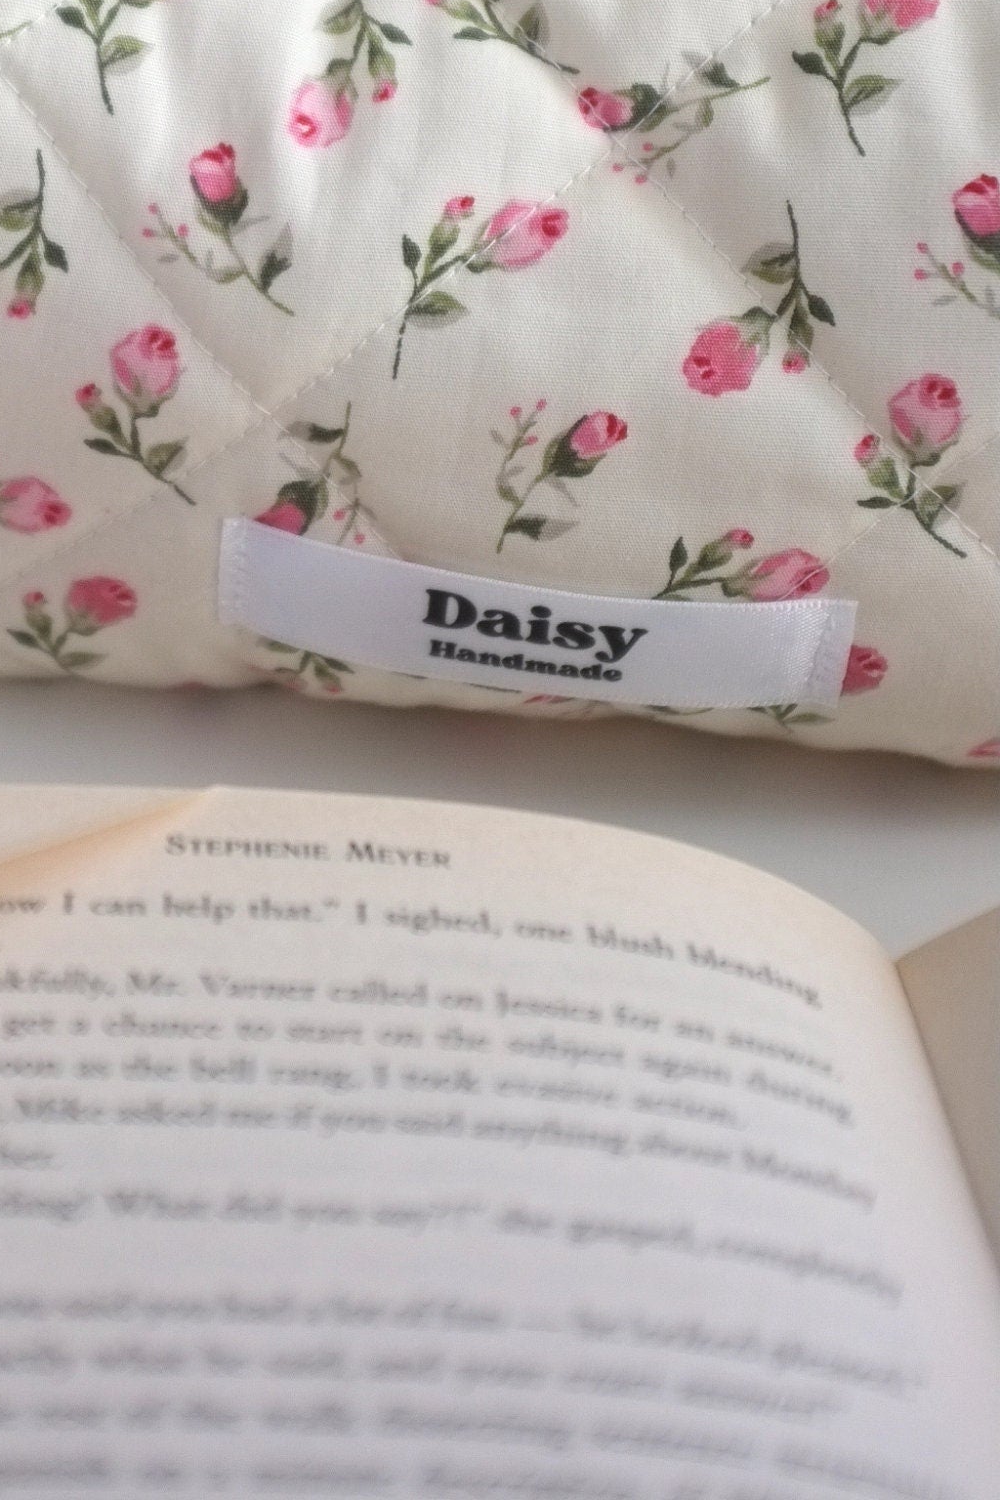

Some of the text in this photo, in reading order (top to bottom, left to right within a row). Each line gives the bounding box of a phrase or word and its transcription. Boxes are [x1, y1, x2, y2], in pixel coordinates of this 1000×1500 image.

[423, 588, 649, 663] Daisy
[430, 639, 623, 681] Handmade
[165, 834, 451, 867] STEPHENIE MEYER
[63, 892, 73, 914] I
[89, 899, 144, 915] can
[164, 893, 233, 925] help
[247, 897, 341, 922] that."
[357, 903, 367, 924] I
[386, 909, 499, 935] sighed,
[515, 924, 570, 941] one
[587, 924, 672, 957] blush
